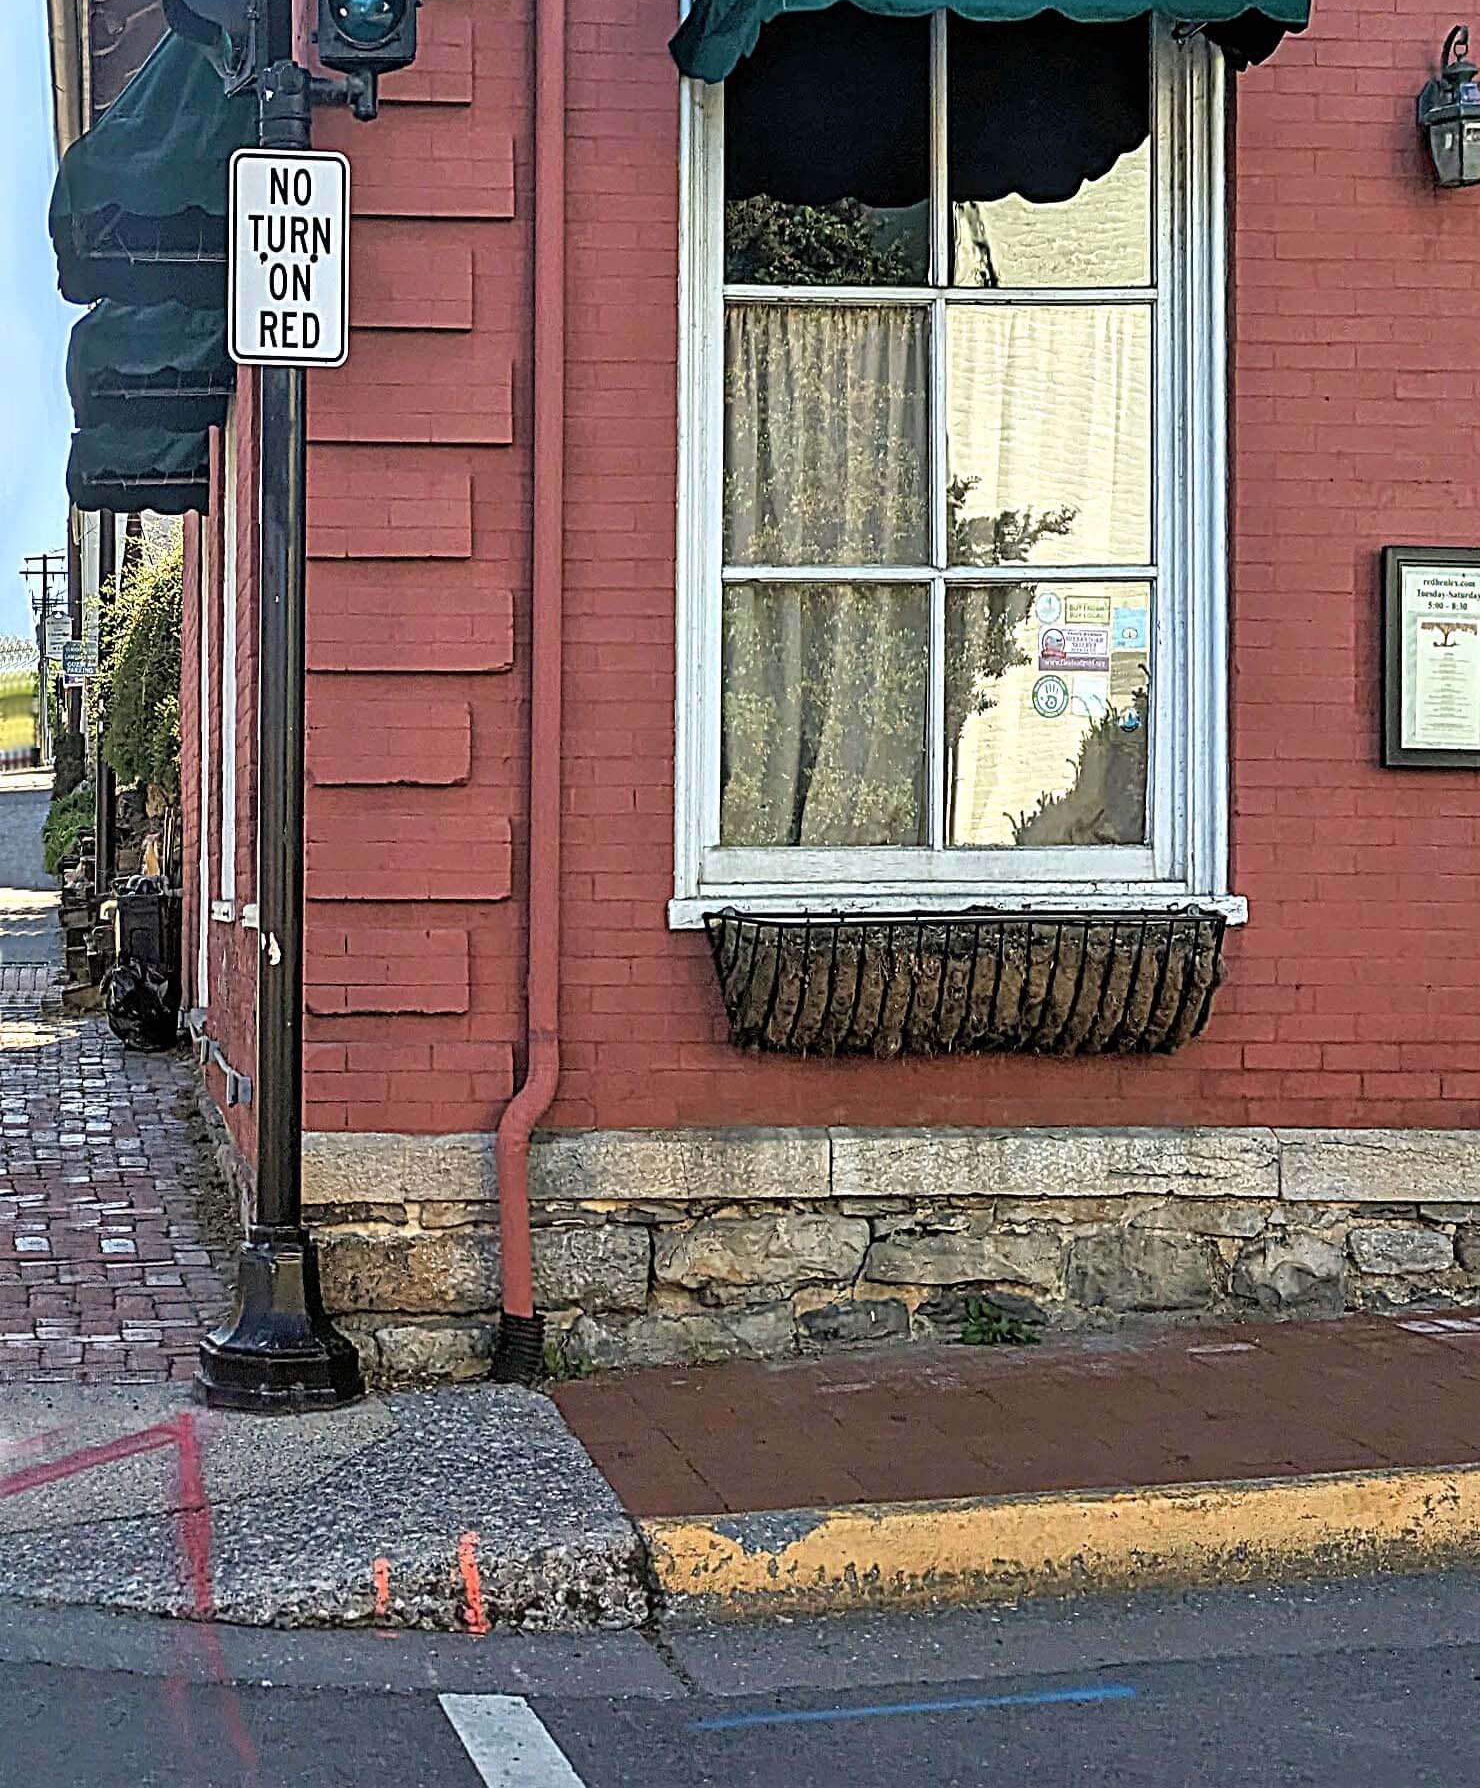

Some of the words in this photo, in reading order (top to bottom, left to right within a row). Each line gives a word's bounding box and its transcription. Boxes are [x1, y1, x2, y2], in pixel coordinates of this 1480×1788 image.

[270, 167, 312, 206] NO
[248, 214, 331, 254] TURN
[269, 263, 311, 301] ON
[260, 310, 320, 349] RED
